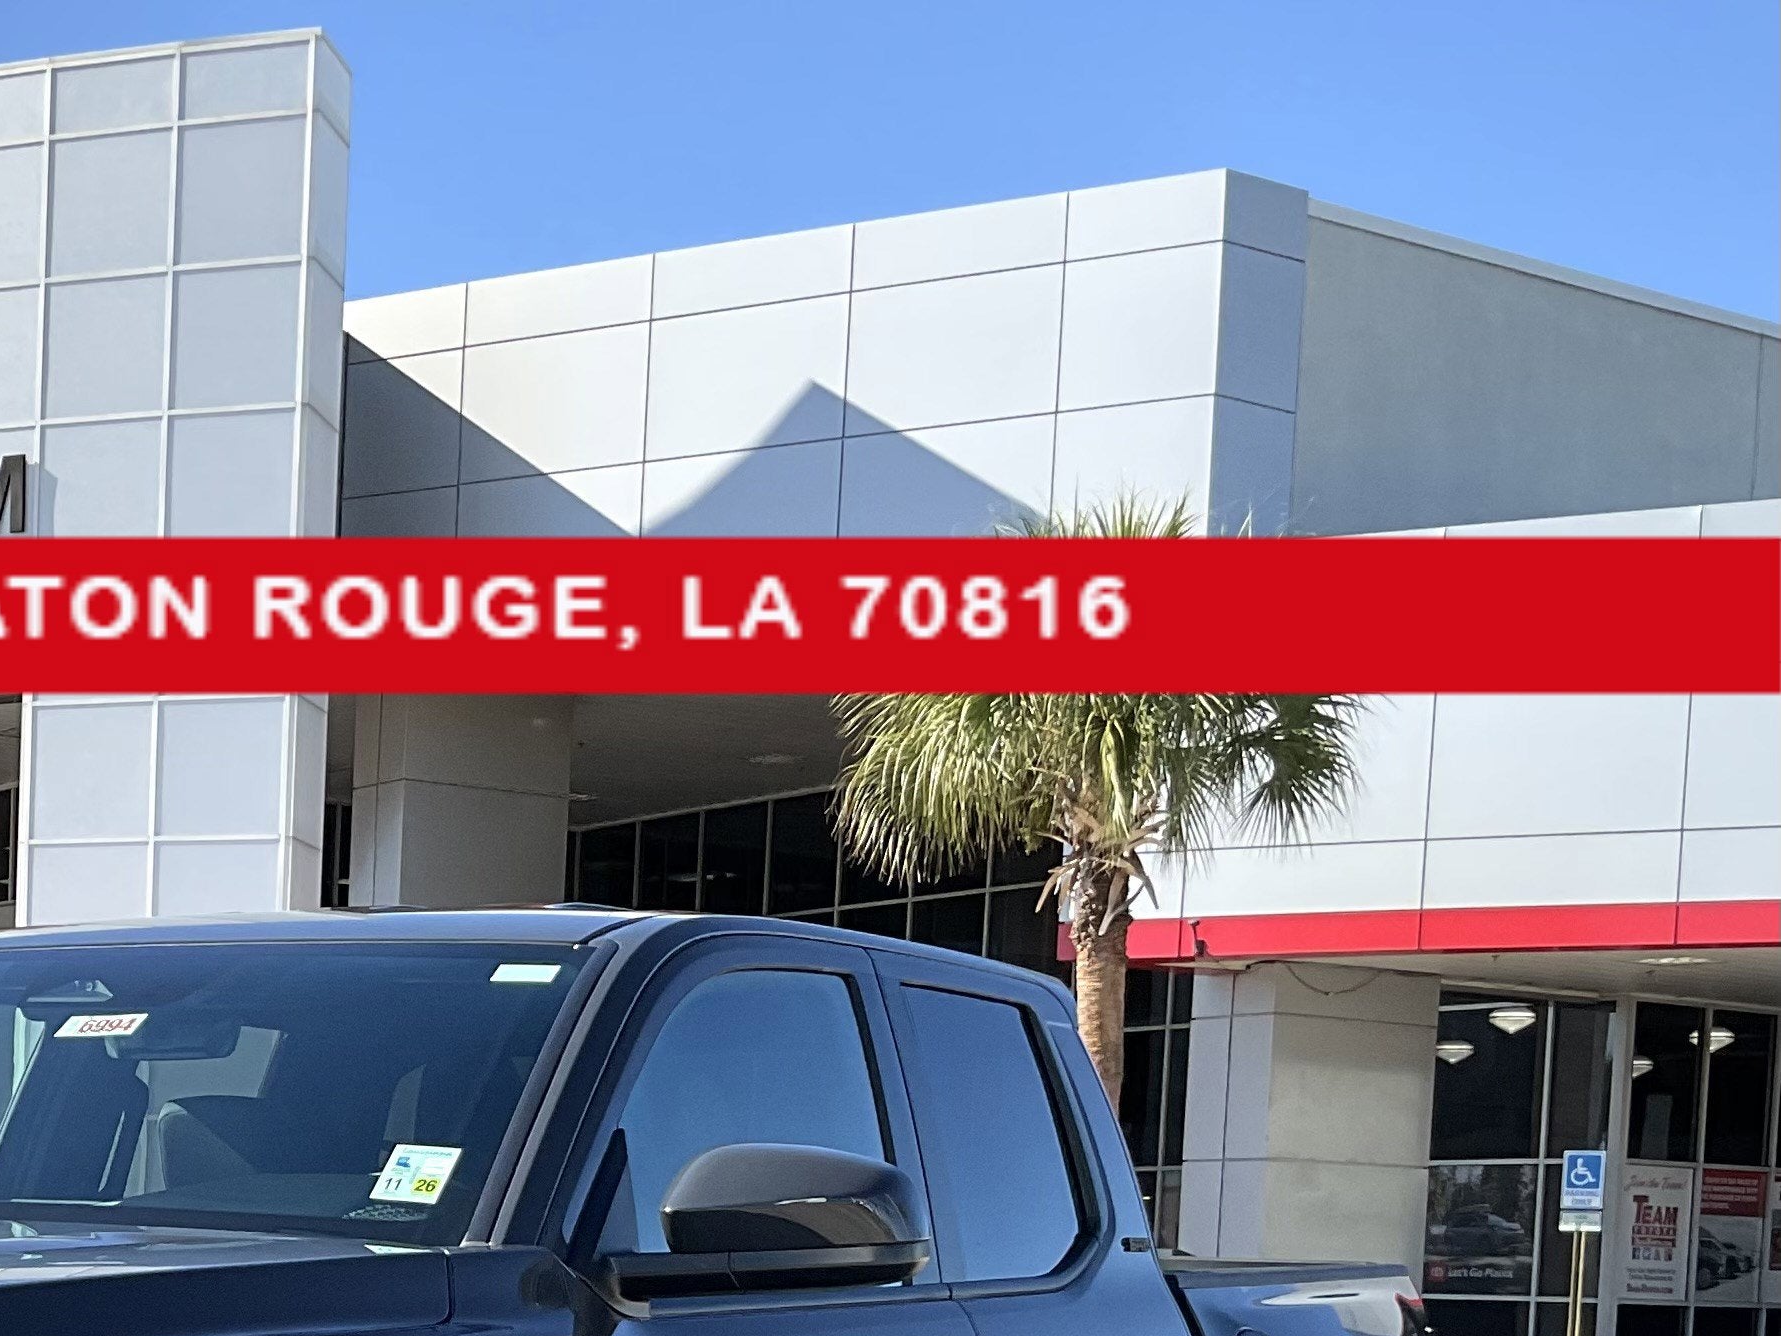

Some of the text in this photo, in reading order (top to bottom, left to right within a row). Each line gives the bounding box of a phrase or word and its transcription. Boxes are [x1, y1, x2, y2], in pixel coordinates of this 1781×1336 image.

[384, 1178, 437, 1192] 11 26
[1633, 1195, 1678, 1225] TEAM
